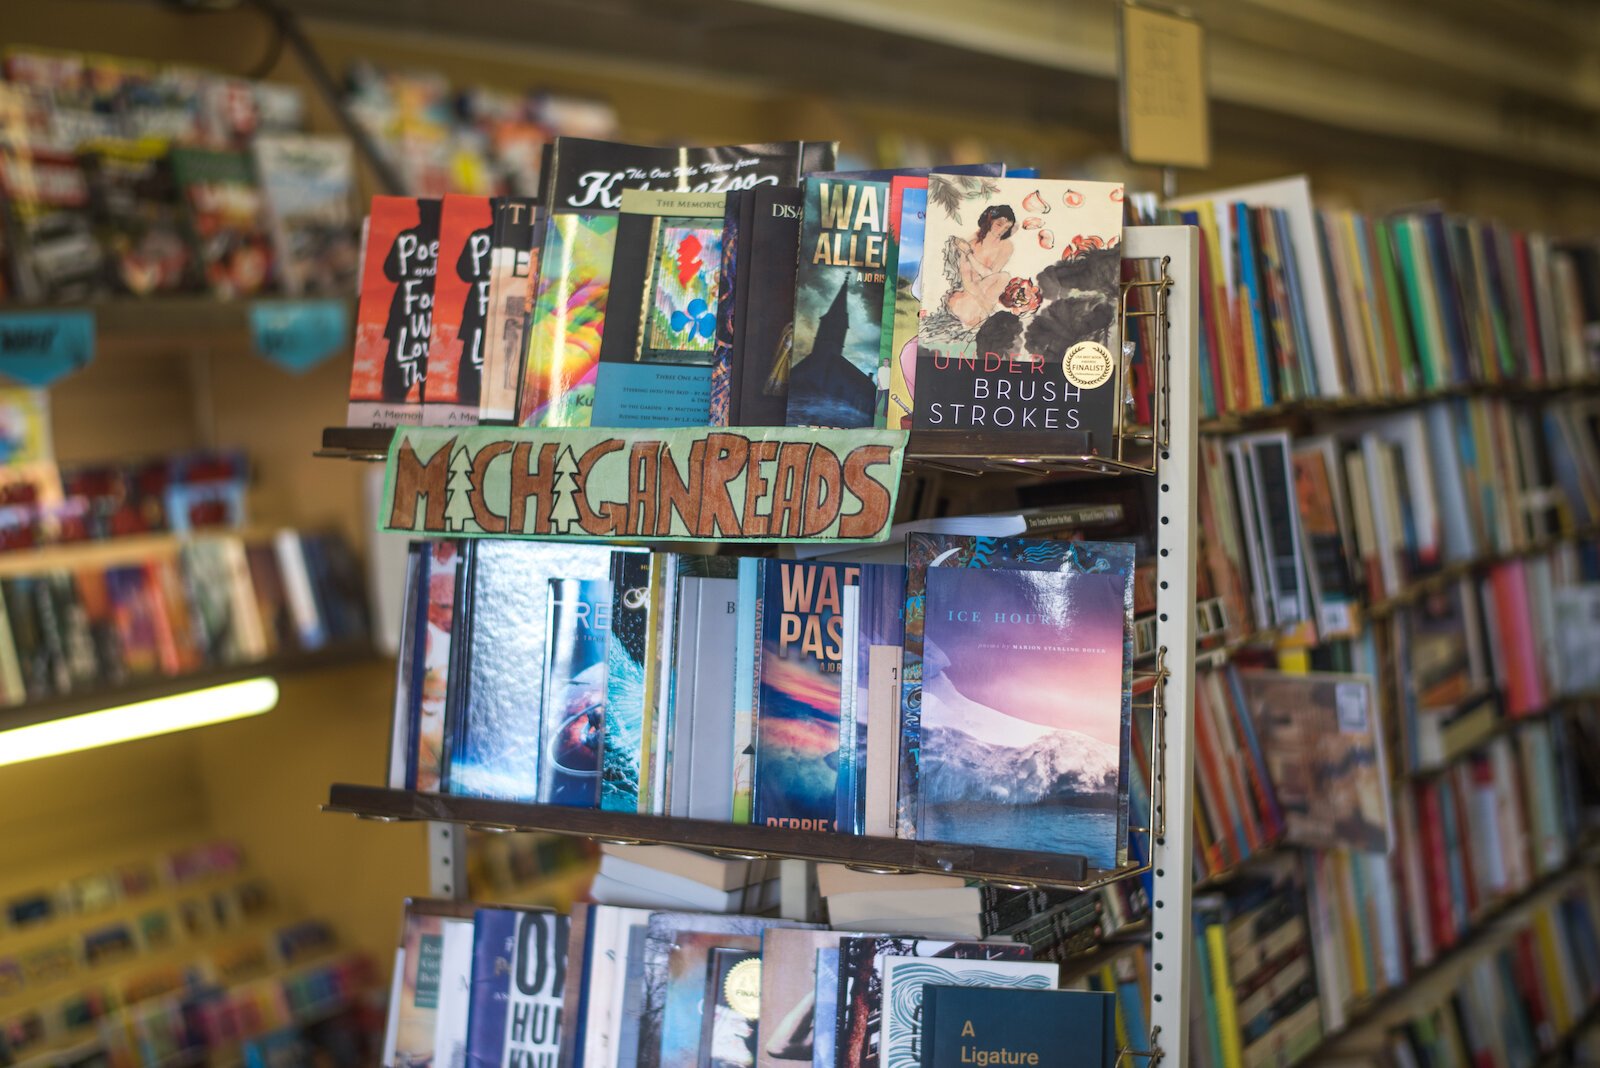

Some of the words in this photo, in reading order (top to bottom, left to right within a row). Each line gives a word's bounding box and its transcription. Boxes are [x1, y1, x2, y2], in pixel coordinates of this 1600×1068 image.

[626, 168, 648, 180] The
[656, 199, 675, 208] THE
[934, 350, 1046, 375] UNDER
[1072, 364, 1105, 372] FINALIST
[974, 378, 1081, 403] BRUSH
[373, 410, 381, 418] A
[449, 411, 457, 419] A
[928, 402, 1081, 430] STROKES
[695, 432, 894, 539] READS
[948, 610, 982, 623] ICE
[961, 1019, 976, 1038] A
[960, 1045, 1040, 1067] Ligature
